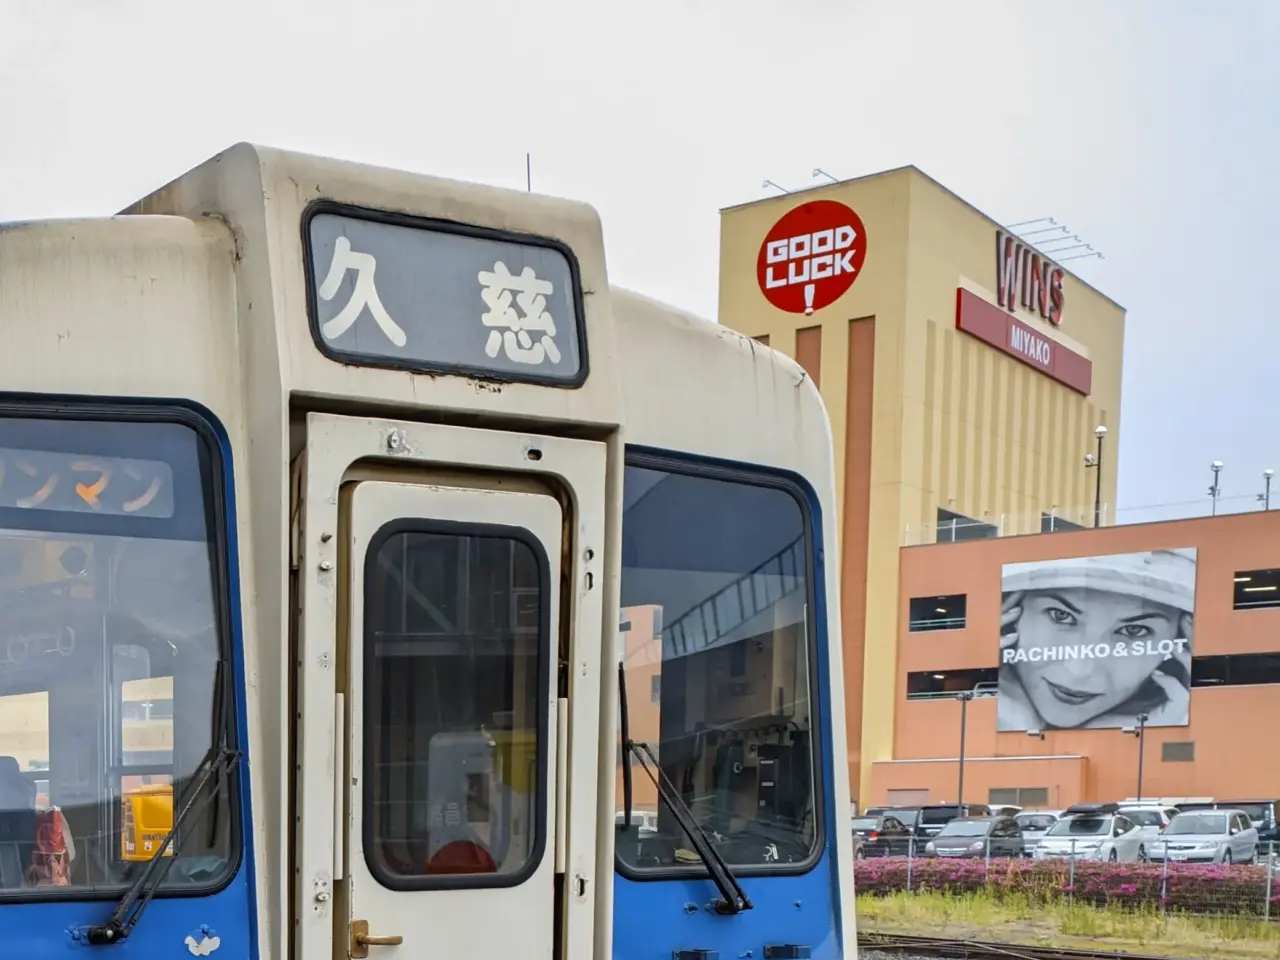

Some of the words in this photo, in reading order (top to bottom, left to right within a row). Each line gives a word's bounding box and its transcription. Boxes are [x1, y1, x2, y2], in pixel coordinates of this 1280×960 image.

[766, 225, 857, 264] GOOD
[766, 249, 856, 289] LUCK
[996, 229, 1065, 327] WINS
[319, 236, 561, 364] 久慈
[1011, 325, 1050, 365] MIYAKO
